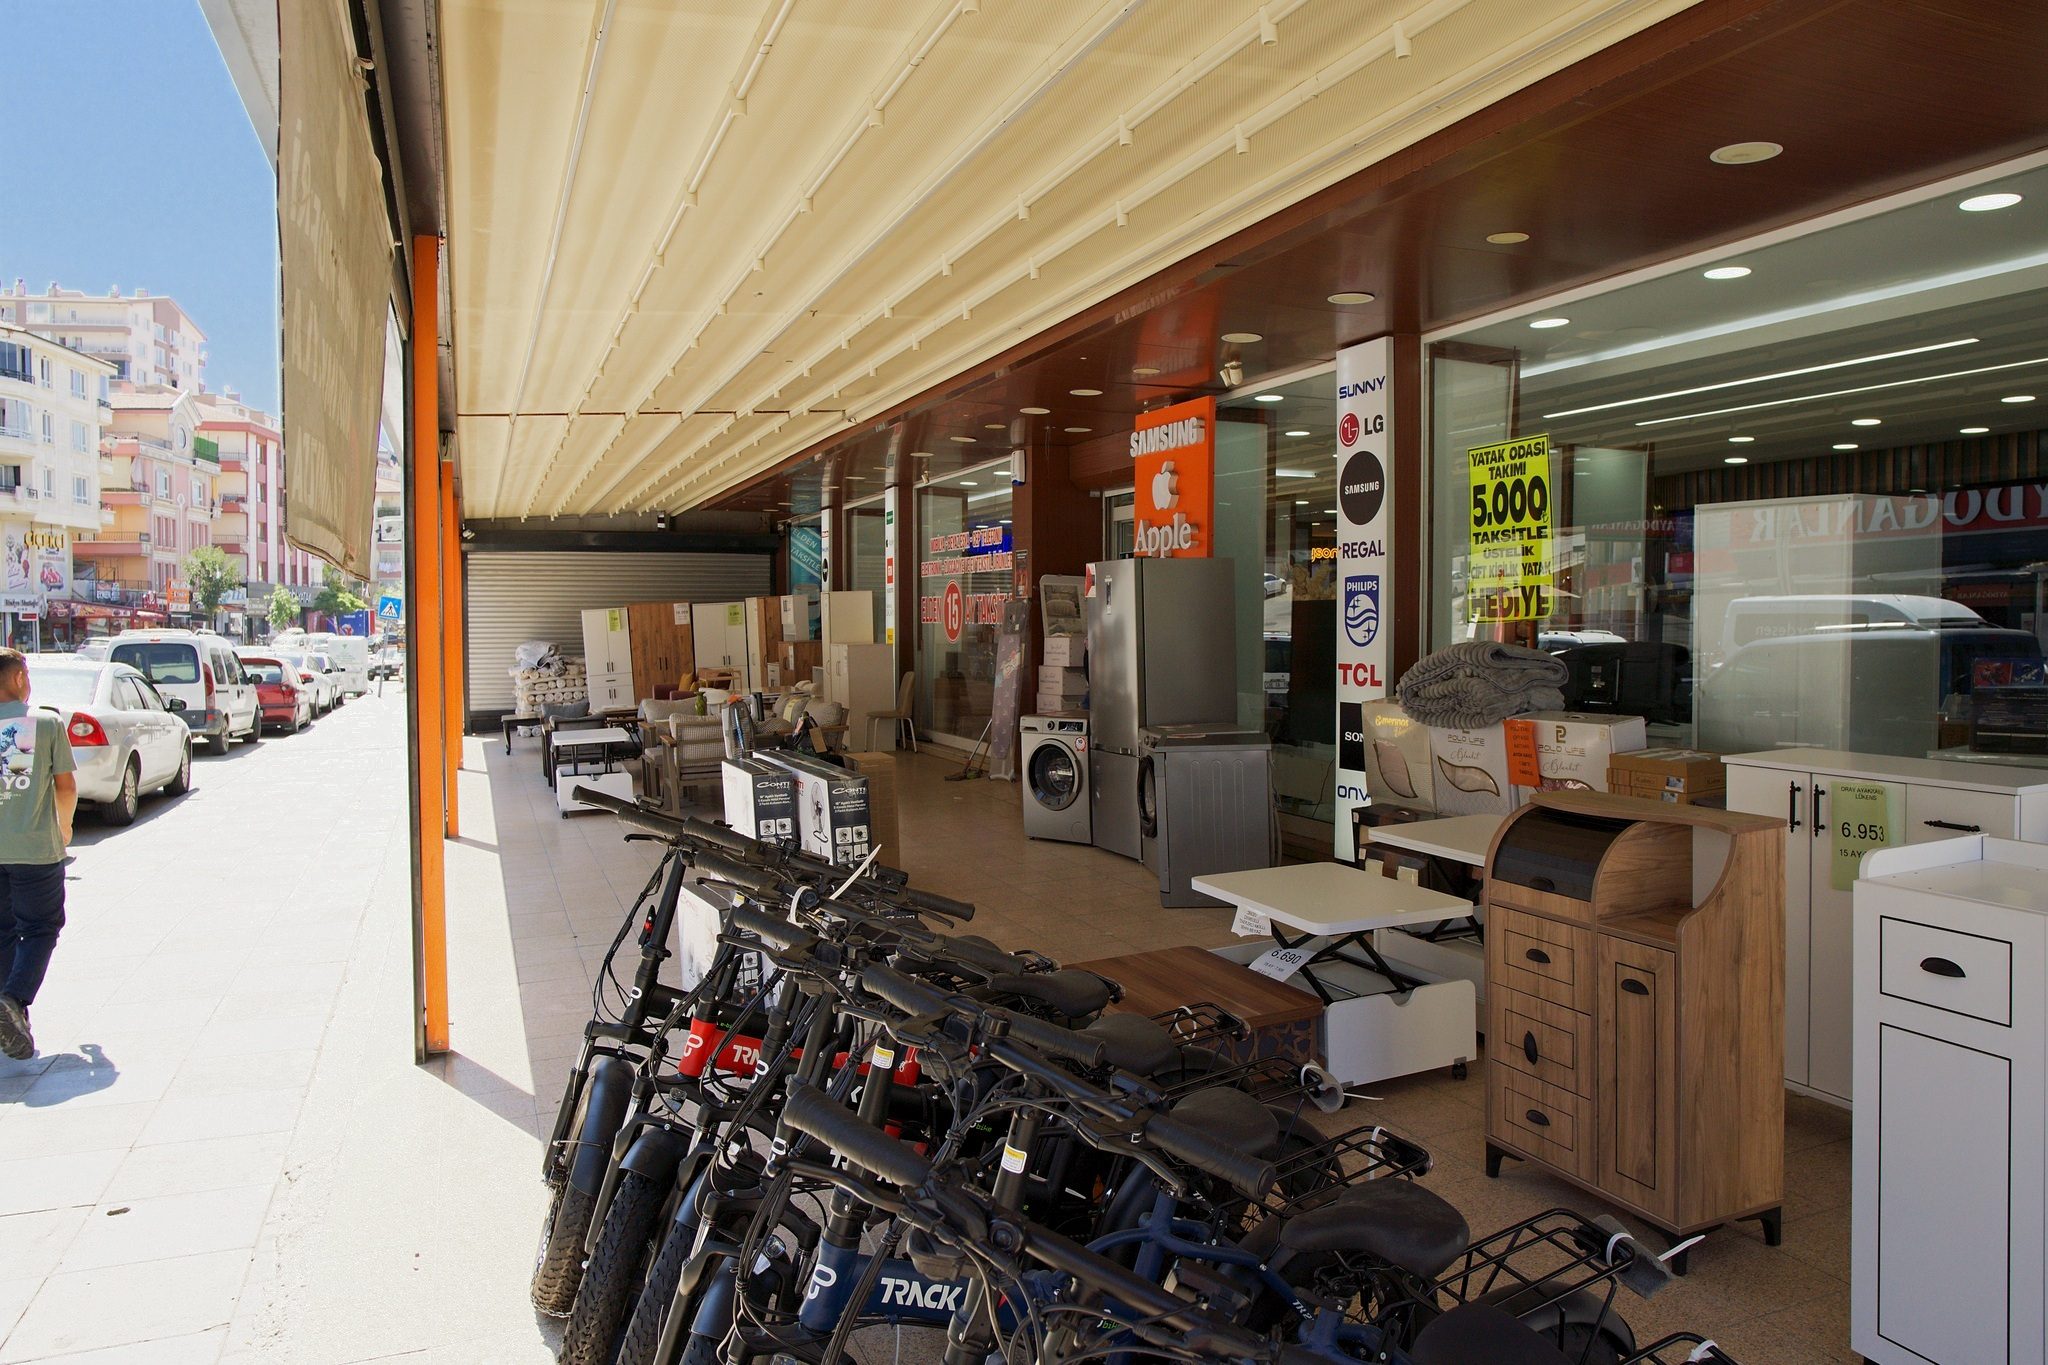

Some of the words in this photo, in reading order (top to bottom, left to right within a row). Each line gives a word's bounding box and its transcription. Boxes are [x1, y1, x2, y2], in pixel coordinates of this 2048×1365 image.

[1338, 375, 1386, 400] SUNNY
[1364, 414, 1384, 436] LG
[1130, 416, 1202, 458] SAMSUNG
[1471, 448, 1506, 467] YATAK
[1508, 440, 1546, 461] ODASI
[1488, 461, 1527, 481] TAKIMI
[1344, 480, 1380, 495] SAMSUNG
[1134, 512, 1196, 558] Apple
[1472, 526, 1548, 545] TAKSİTLE
[1341, 539, 1386, 560] REGAL
[1483, 544, 1535, 559] ÜSTELİK
[1521, 560, 1551, 577] YATAK
[1346, 580, 1378, 592] PHILIPS
[946, 592, 959, 631] 15
[1338, 662, 1382, 687] TCL
[1344, 731, 1363, 742] SON
[1447, 734, 1467, 743] POLO
[1468, 736, 1486, 745] LIFE
[1537, 743, 1563, 753] POLO
[1564, 745, 1585, 755] LIFE
[2, 773, 31, 790] YO
[1841, 821, 1885, 842] 6.953
[1839, 848, 1849, 857] 15
[1271, 948, 1302, 965] 6.690
[733, 1044, 761, 1066] TRA
[880, 1277, 963, 1312] TRACK
